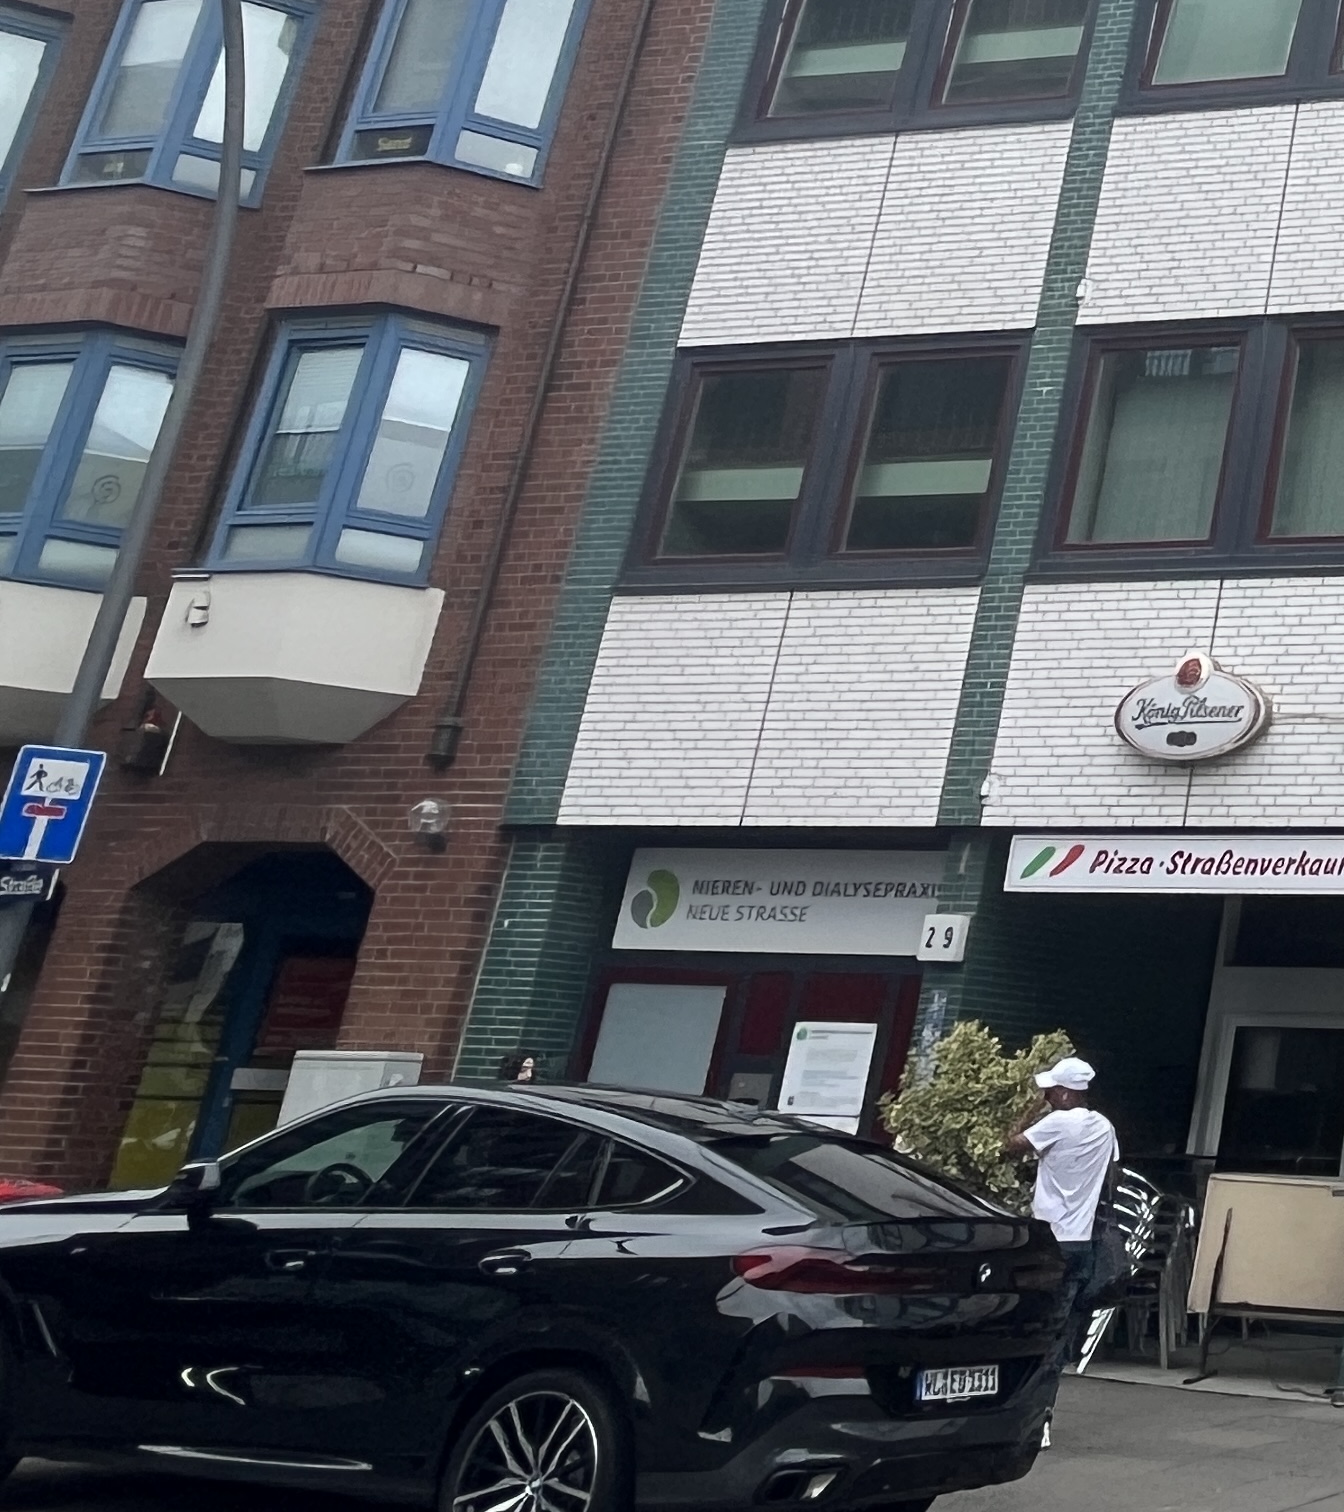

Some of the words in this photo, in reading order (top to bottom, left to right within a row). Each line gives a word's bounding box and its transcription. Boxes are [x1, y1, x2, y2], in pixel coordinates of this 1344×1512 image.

[691, 878, 763, 896] NIEREN-
[769, 879, 807, 897] UND
[686, 903, 730, 922] NEUE
[734, 904, 812, 923] STRASSE
